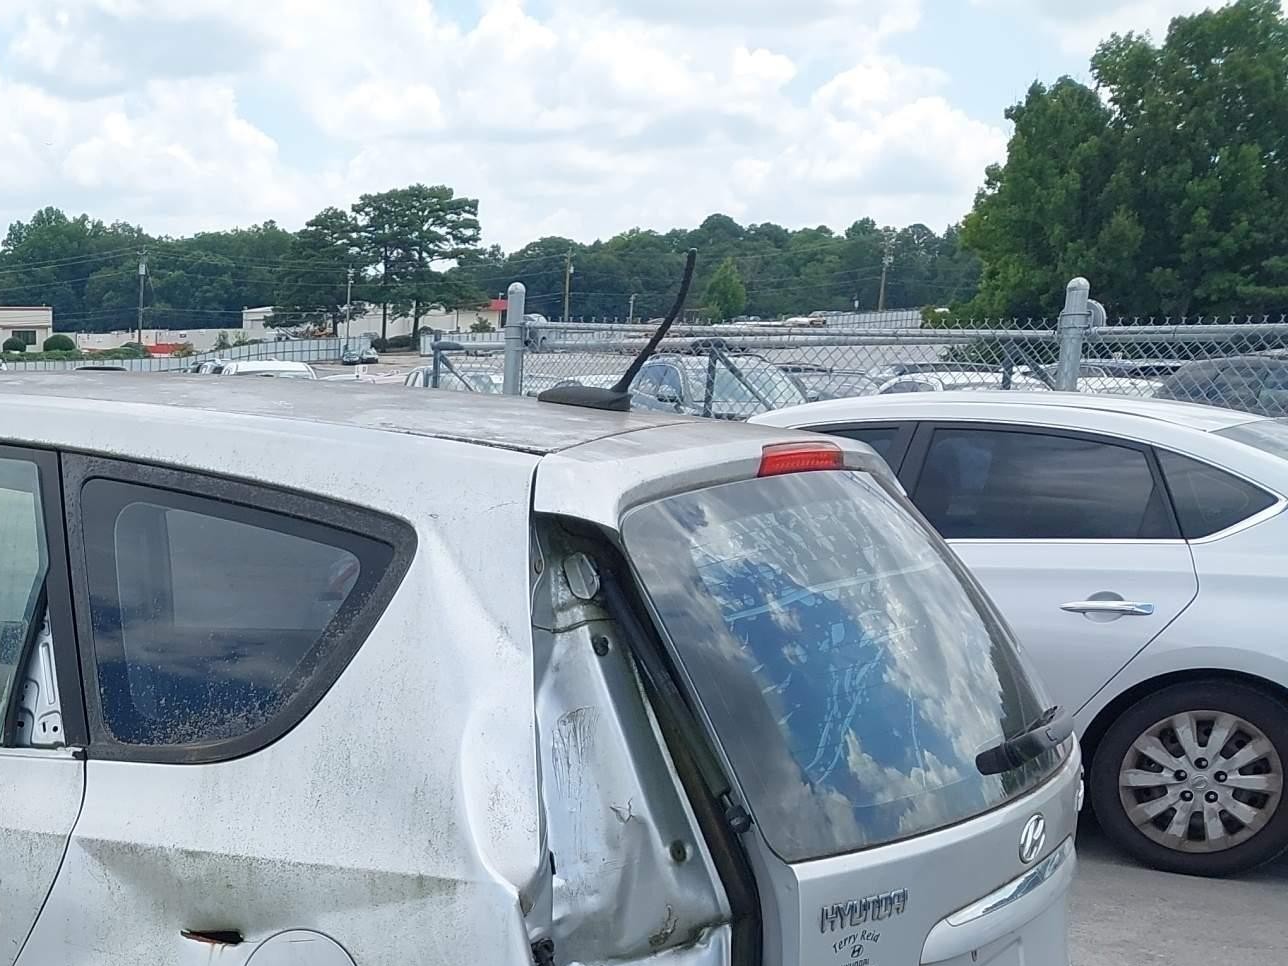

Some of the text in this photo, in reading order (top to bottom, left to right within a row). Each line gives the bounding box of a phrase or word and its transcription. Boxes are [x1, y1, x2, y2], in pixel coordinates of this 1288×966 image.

[820, 888, 908, 933] HYUNDAI
[833, 930, 880, 953] Terry Reid
